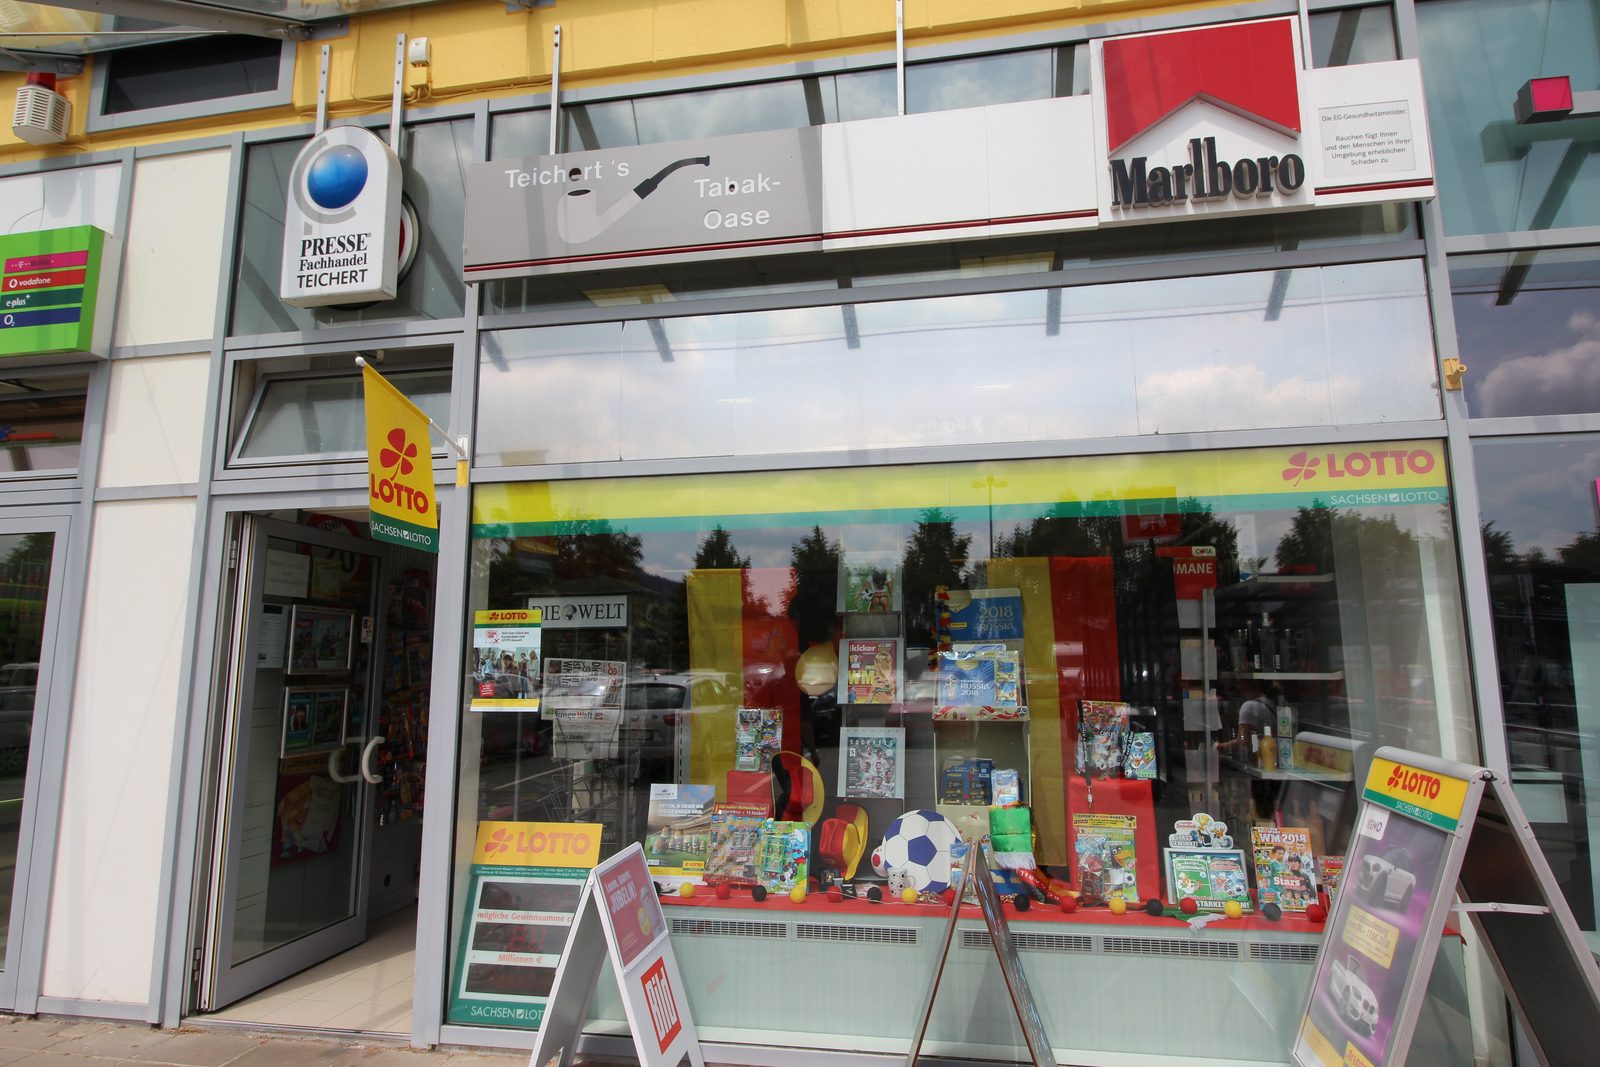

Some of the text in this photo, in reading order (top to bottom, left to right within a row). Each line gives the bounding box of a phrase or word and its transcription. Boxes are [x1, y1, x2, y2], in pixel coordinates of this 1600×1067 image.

[1321, 114, 1332, 122] Die
[1335, 133, 1363, 142] Rauchen
[1364, 132, 1378, 141] fügt
[1352, 140, 1386, 149] Menschen
[1331, 147, 1406, 160] Umgebung erheblichen
[1350, 158, 1379, 166] Schaden
[1109, 136, 1305, 209] Marlboro
[694, 173, 781, 199] Tabak-
[703, 209, 770, 230] Oase
[300, 233, 369, 258] PRESSE
[299, 253, 368, 272] Fachhandel
[19, 277, 52, 287] vodafone
[297, 268, 369, 289] TEICHERT
[1327, 449, 1435, 478] LOTTO
[371, 472, 429, 514] LOTTO
[1173, 562, 1213, 575] MANE
[500, 612, 528, 621] LOTTO
[578, 603, 625, 620] WELT
[979, 605, 1014, 619] 2018
[851, 644, 876, 652] kicker
[848, 670, 875, 685] WM
[960, 682, 991, 690] RUSSIA
[1401, 770, 1441, 800] LOTTO
[516, 831, 591, 855] LOTTO
[1259, 833, 1307, 843] WM 2018
[1273, 876, 1301, 887] Stars
[477, 911, 509, 922] mögliche
[511, 912, 565, 923] Gewinnsumme
[498, 953, 534, 964] Millionen
[471, 1005, 545, 1021] SACHSEN LOT
